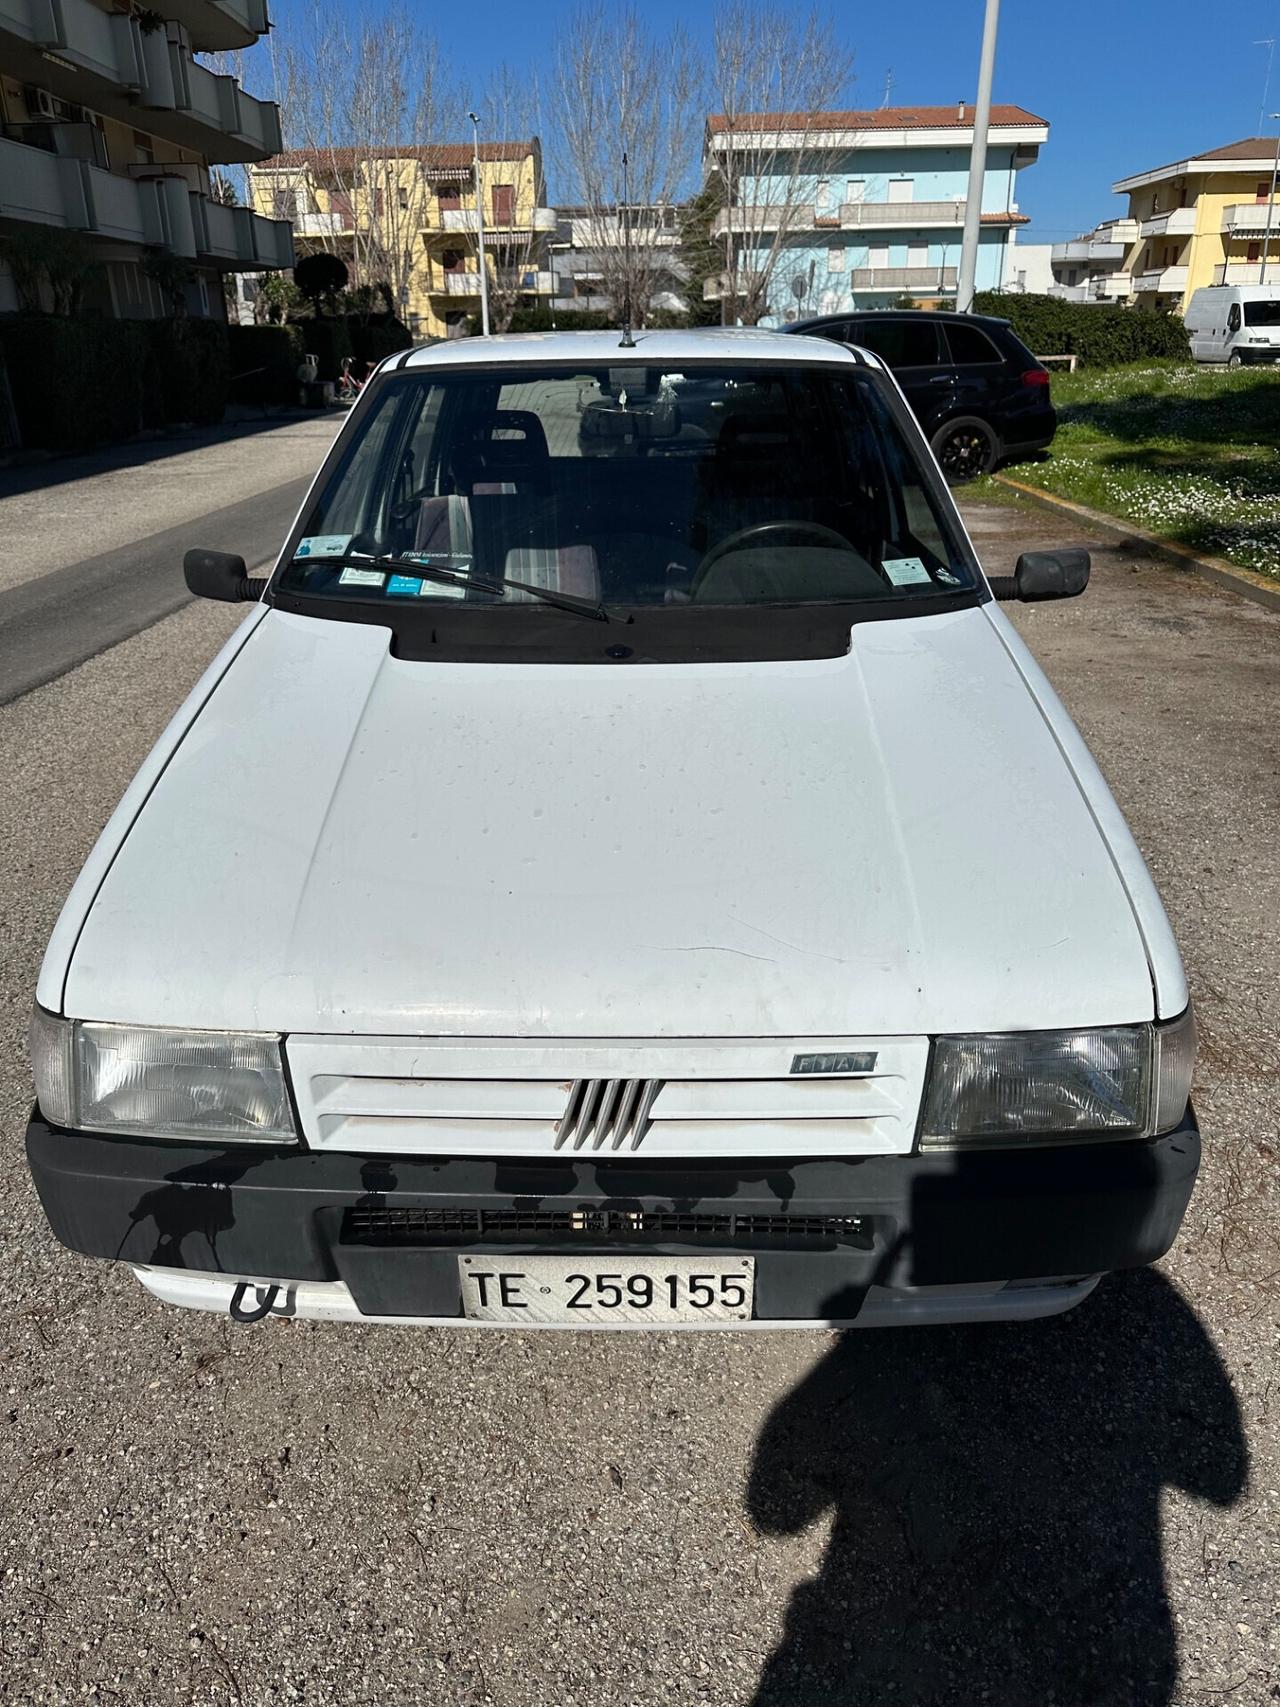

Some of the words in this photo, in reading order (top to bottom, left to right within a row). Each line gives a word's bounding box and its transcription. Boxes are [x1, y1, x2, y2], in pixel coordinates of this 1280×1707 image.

[798, 1055, 872, 1071] FIAT
[467, 1272, 528, 1308] TE
[565, 1273, 747, 1309] 259155
